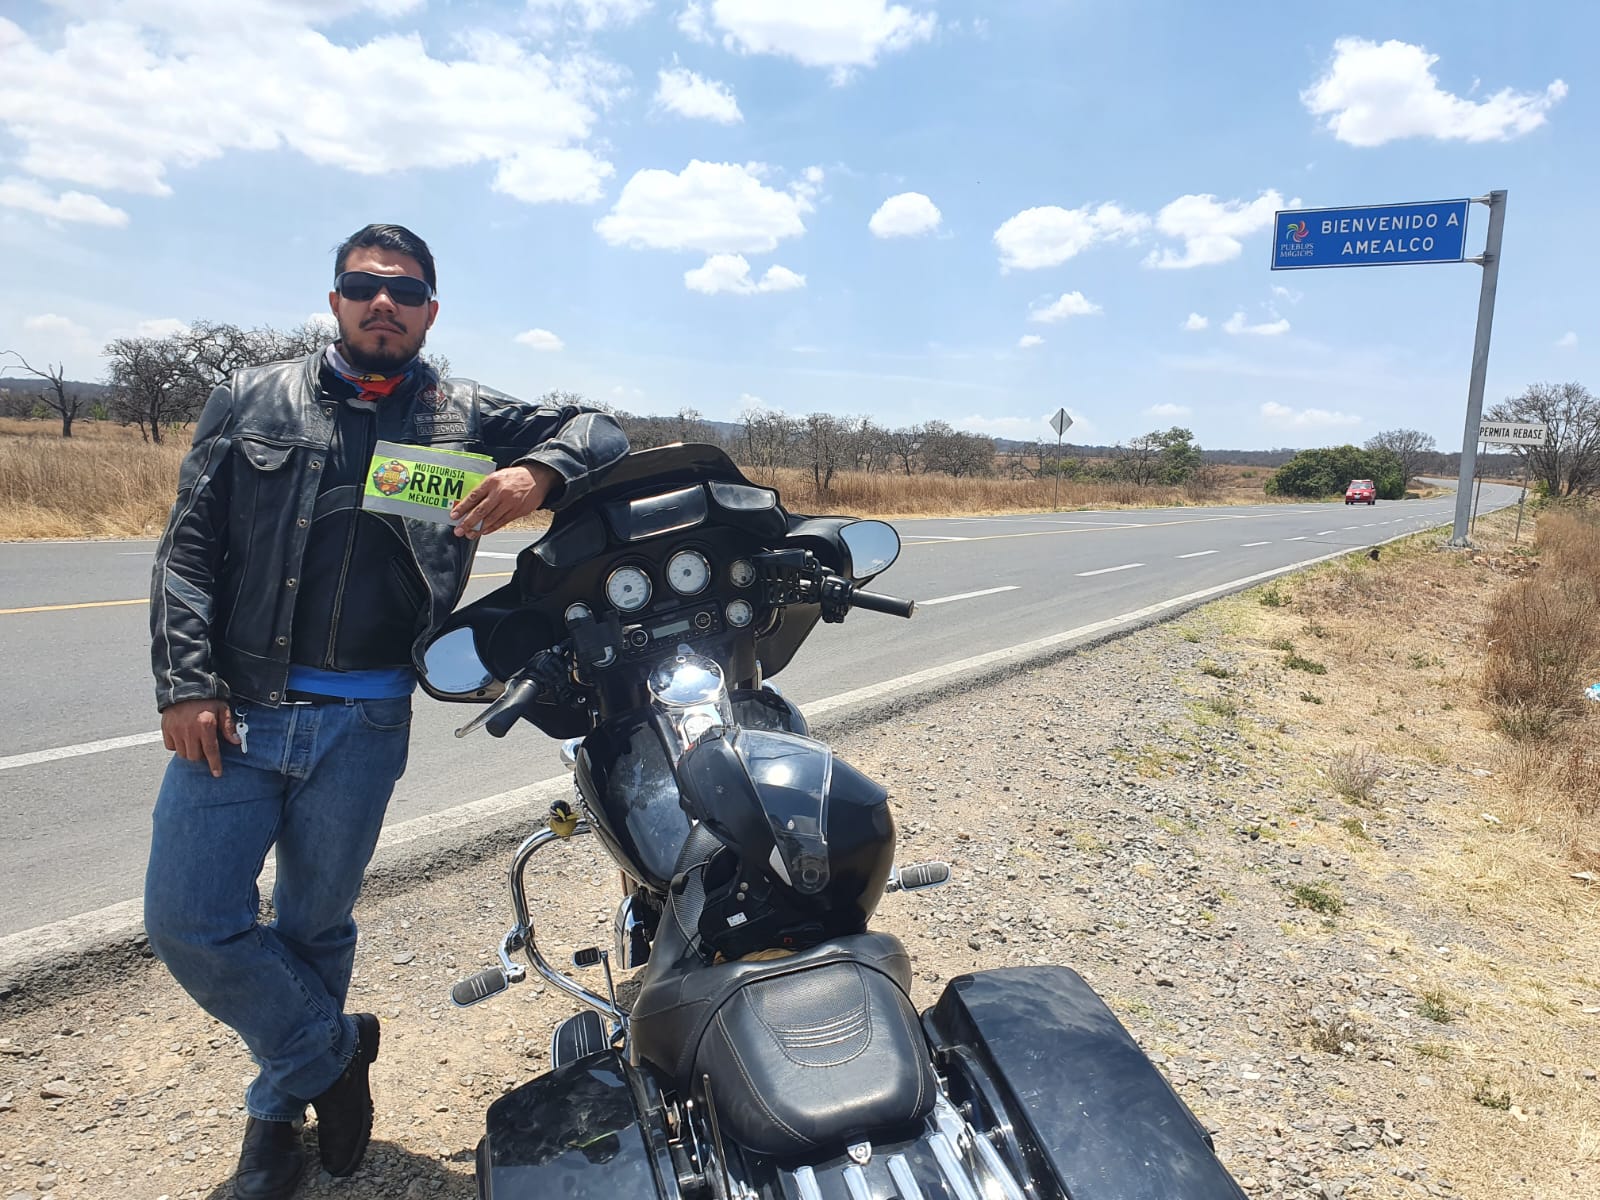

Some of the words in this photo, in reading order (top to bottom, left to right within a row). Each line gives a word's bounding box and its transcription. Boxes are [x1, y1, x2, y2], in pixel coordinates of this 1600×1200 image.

[1321, 213, 1437, 234] BIENVENIDO
[1447, 212, 1459, 226] A
[1341, 237, 1434, 256] AMEALCO
[1480, 427, 1510, 437] PERMITA
[1513, 429, 1543, 439] REBASE
[414, 463, 465, 479] MOTOTURISTA
[409, 471, 464, 499] RRM
